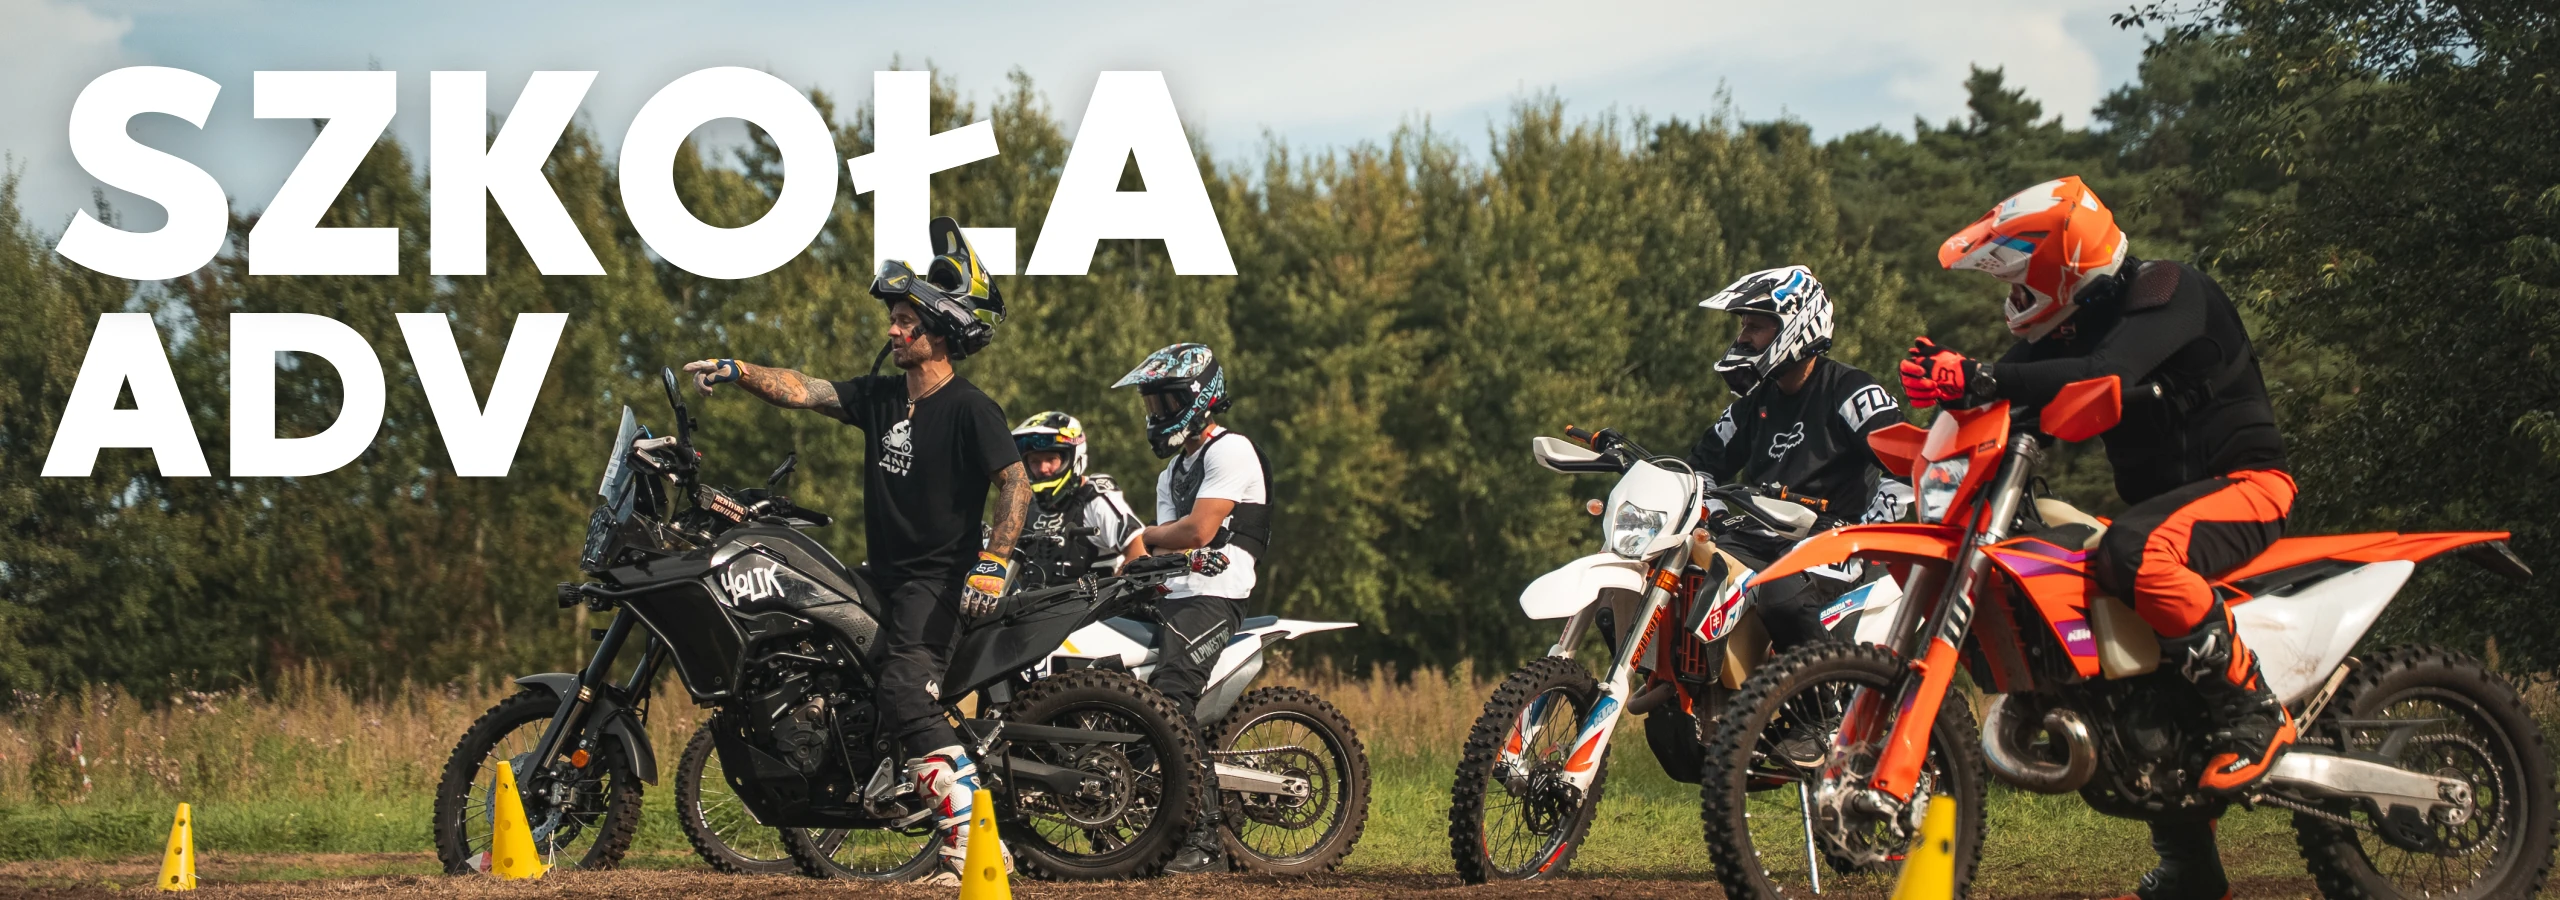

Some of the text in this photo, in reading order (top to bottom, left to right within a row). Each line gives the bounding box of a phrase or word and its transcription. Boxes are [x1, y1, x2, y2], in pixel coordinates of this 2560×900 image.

[710, 502, 742, 523] RENTHAL
[714, 494, 746, 515] RENTHAL
[1593, 701, 1619, 728] KTM
